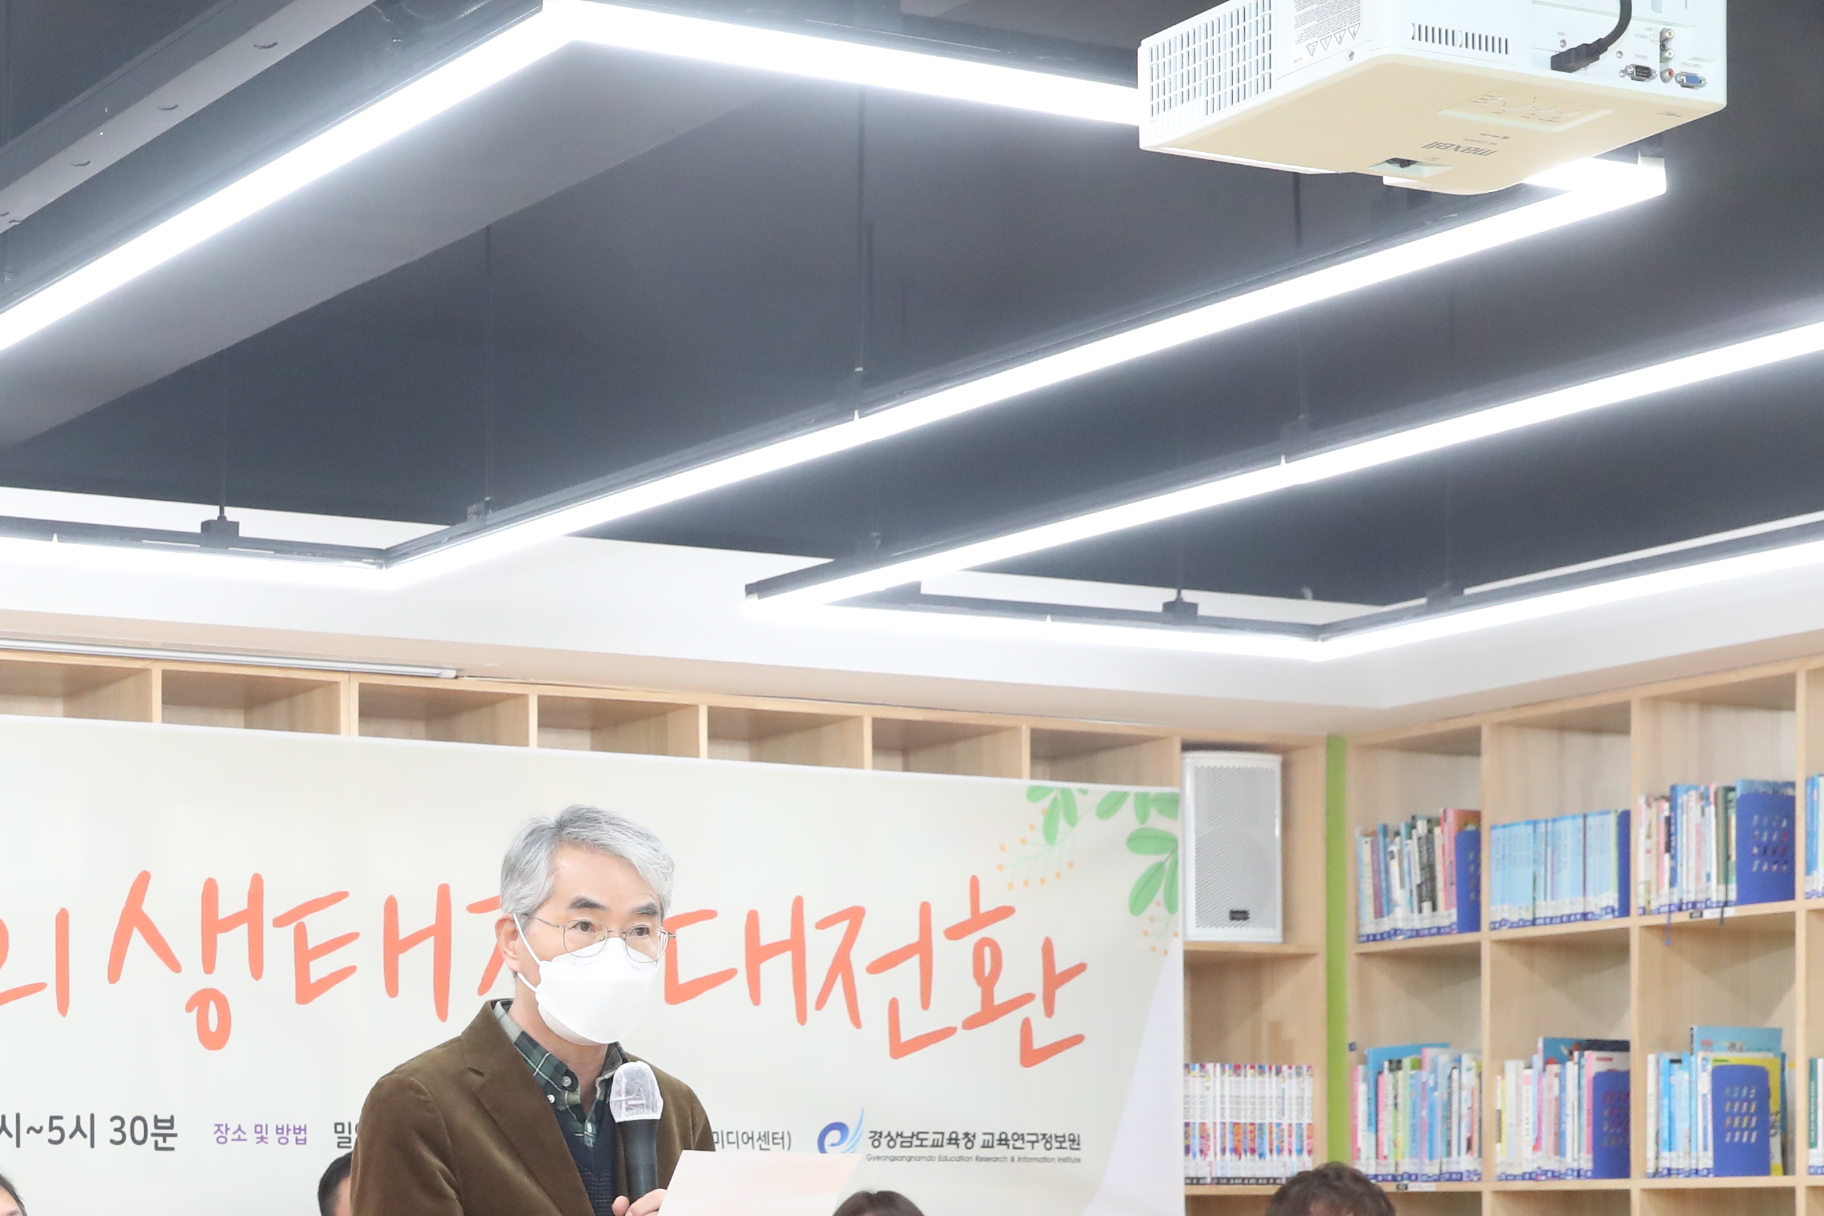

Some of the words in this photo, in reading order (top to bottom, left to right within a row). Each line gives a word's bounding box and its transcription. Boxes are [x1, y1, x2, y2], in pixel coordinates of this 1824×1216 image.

[1421, 141, 1497, 156] maxell
[663, 875, 1088, 1068] 대전환
[108, 1114, 179, 1152] 30분
[213, 1123, 248, 1145] 장소
[254, 1123, 269, 1145] 및
[275, 1123, 307, 1146] 방법
[333, 1121, 360, 1149] 밀
[868, 1130, 976, 1151] 경상남도교육청
[980, 1131, 1082, 1151] 교육연구정보원
[866, 1153, 936, 1163] Gyeongsangnamdo
[938, 1154, 973, 1163] Education
